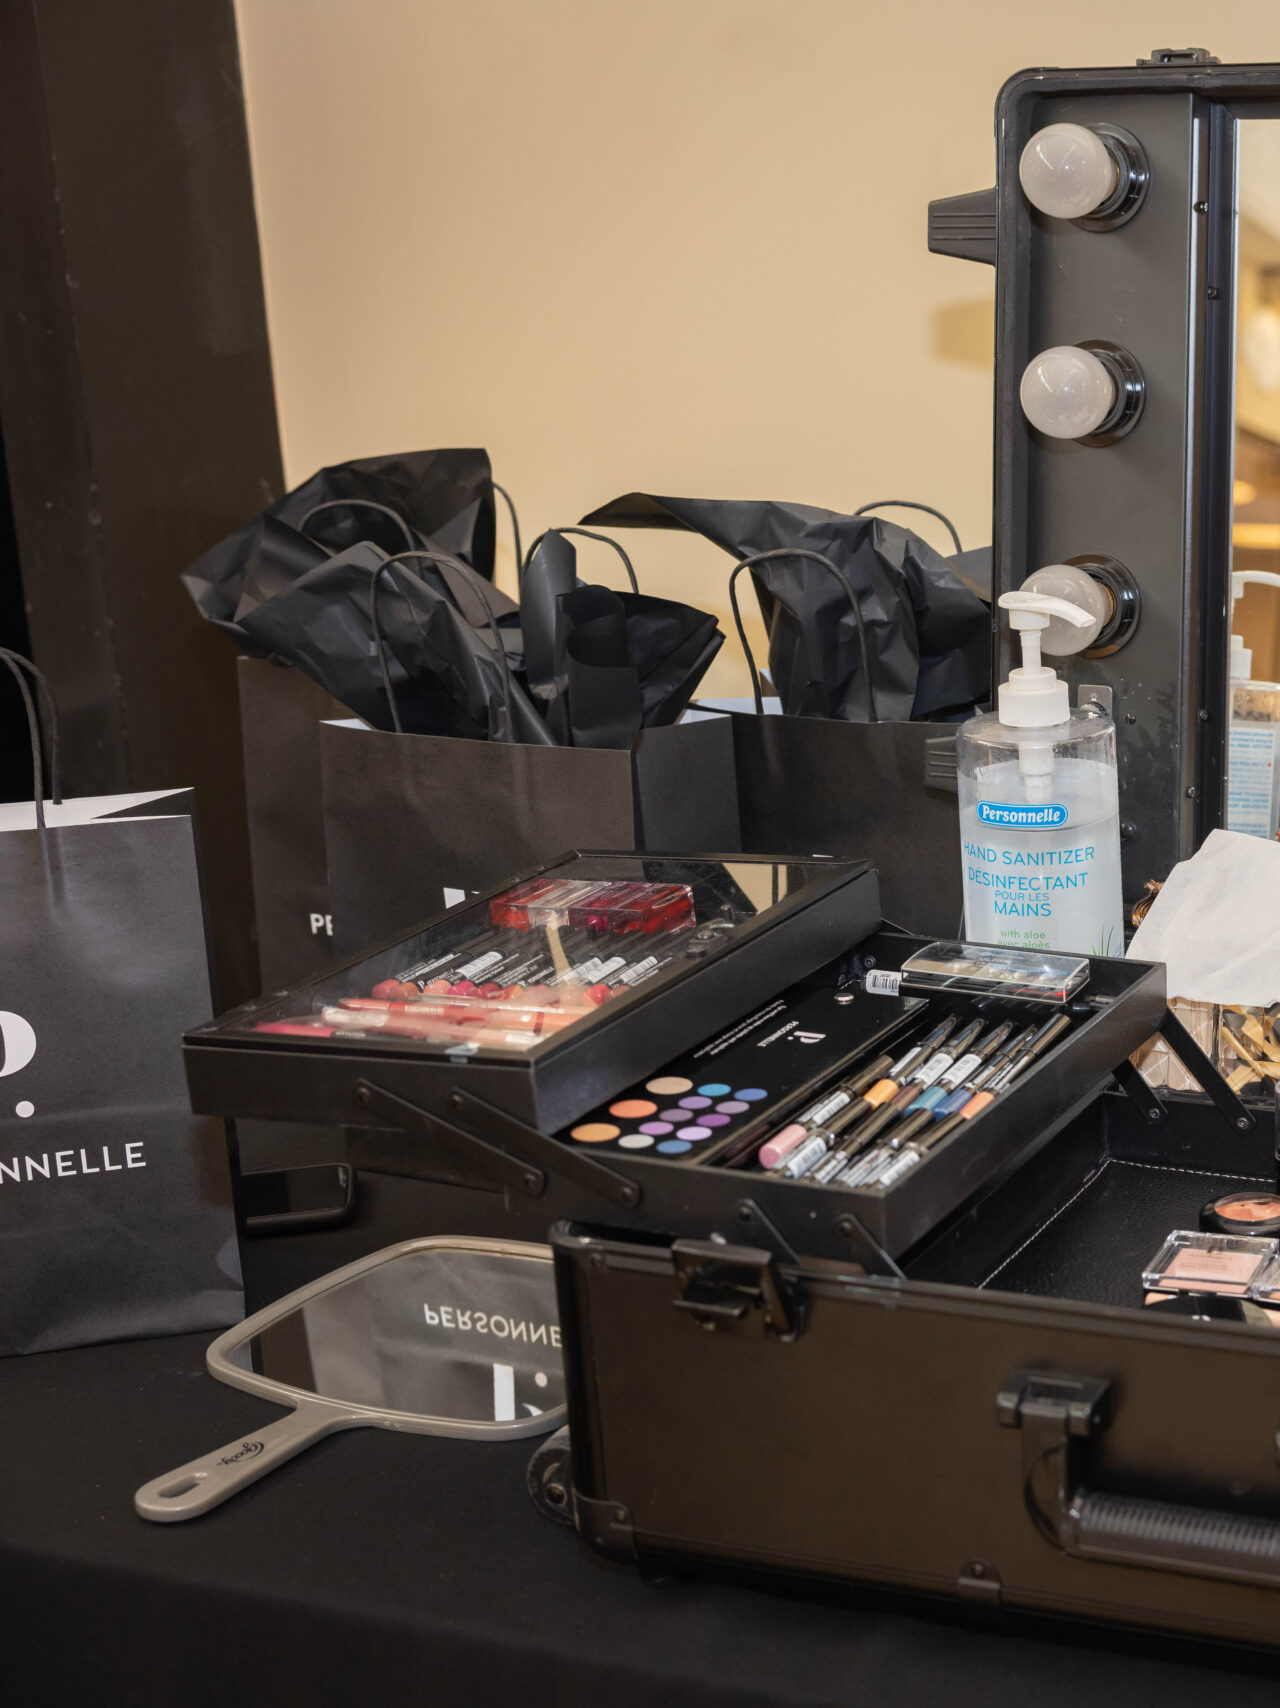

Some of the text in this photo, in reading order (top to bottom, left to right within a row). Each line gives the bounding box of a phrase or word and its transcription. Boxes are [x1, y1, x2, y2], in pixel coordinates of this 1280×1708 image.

[982, 805, 1061, 823] Personnelle
[964, 840, 1095, 866] HAND SANITIZER
[968, 866, 1088, 891] DÉSINFECTANT
[995, 890, 1050, 902] POUR LES
[994, 901, 1052, 917] MAINS
[1000, 929, 1046, 940] with aloe
